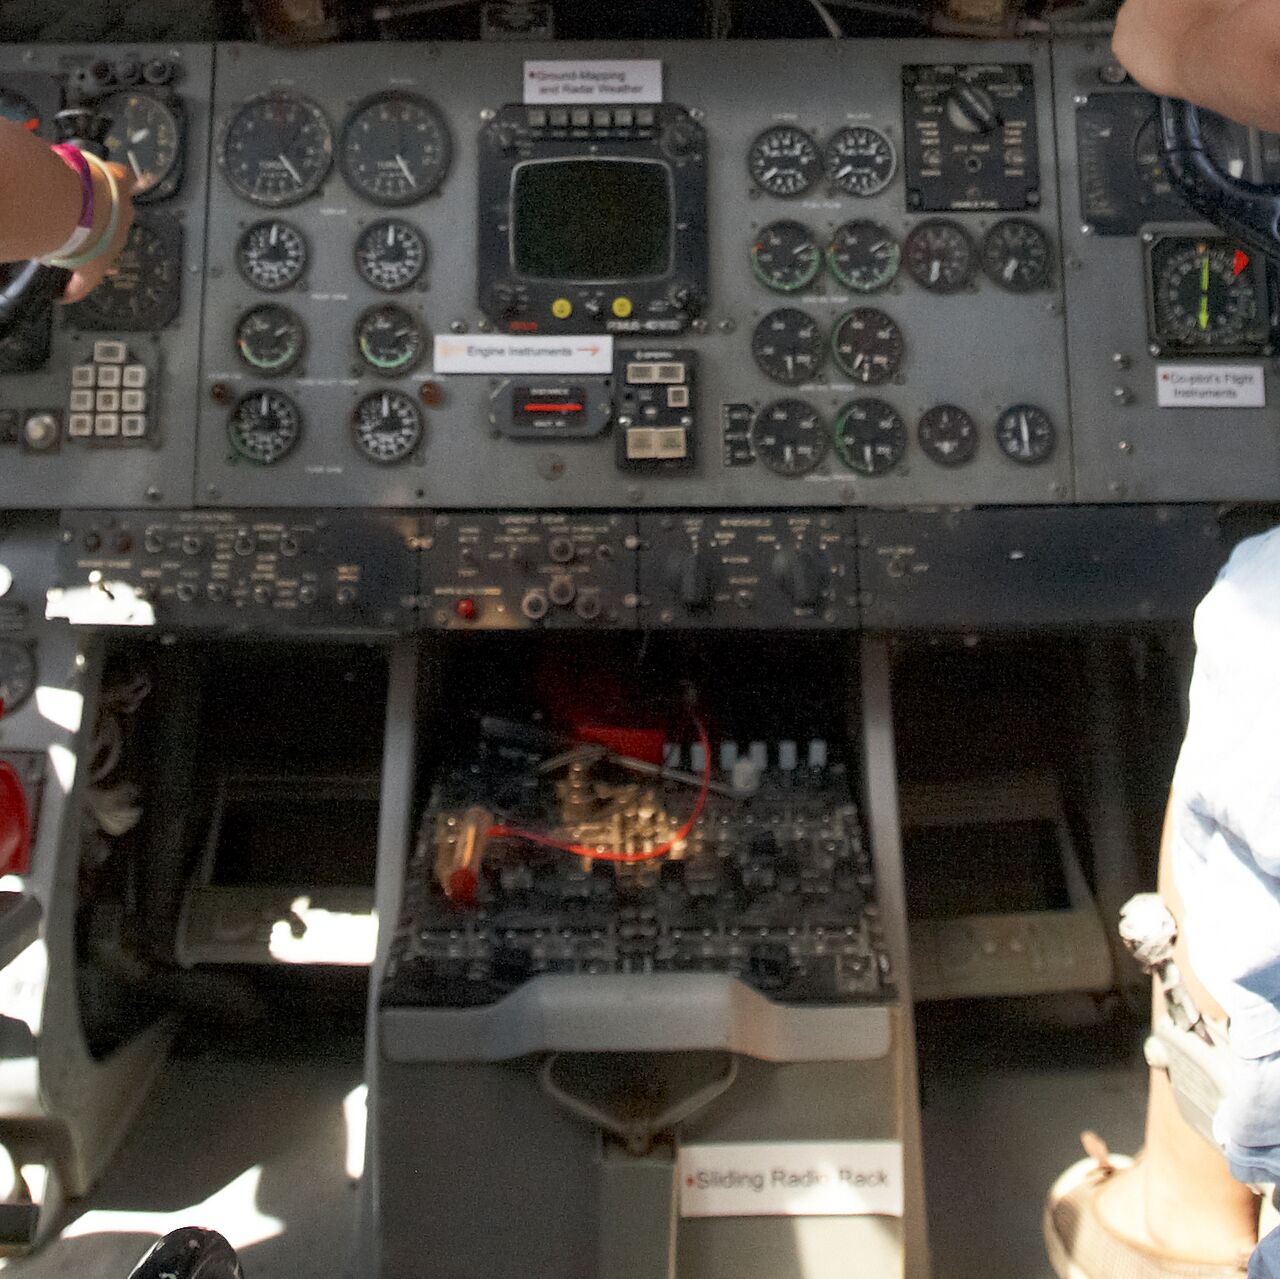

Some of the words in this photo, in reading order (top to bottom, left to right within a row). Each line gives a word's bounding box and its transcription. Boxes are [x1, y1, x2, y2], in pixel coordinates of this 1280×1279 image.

[539, 84, 560, 95] and
[562, 84, 594, 95] Radar
[466, 345, 505, 359] Engine
[509, 345, 572, 357] Instruments
[1225, 372, 1254, 386] Flight
[1174, 387, 1237, 399] Instruments
[696, 1170, 764, 1192] Sliding
